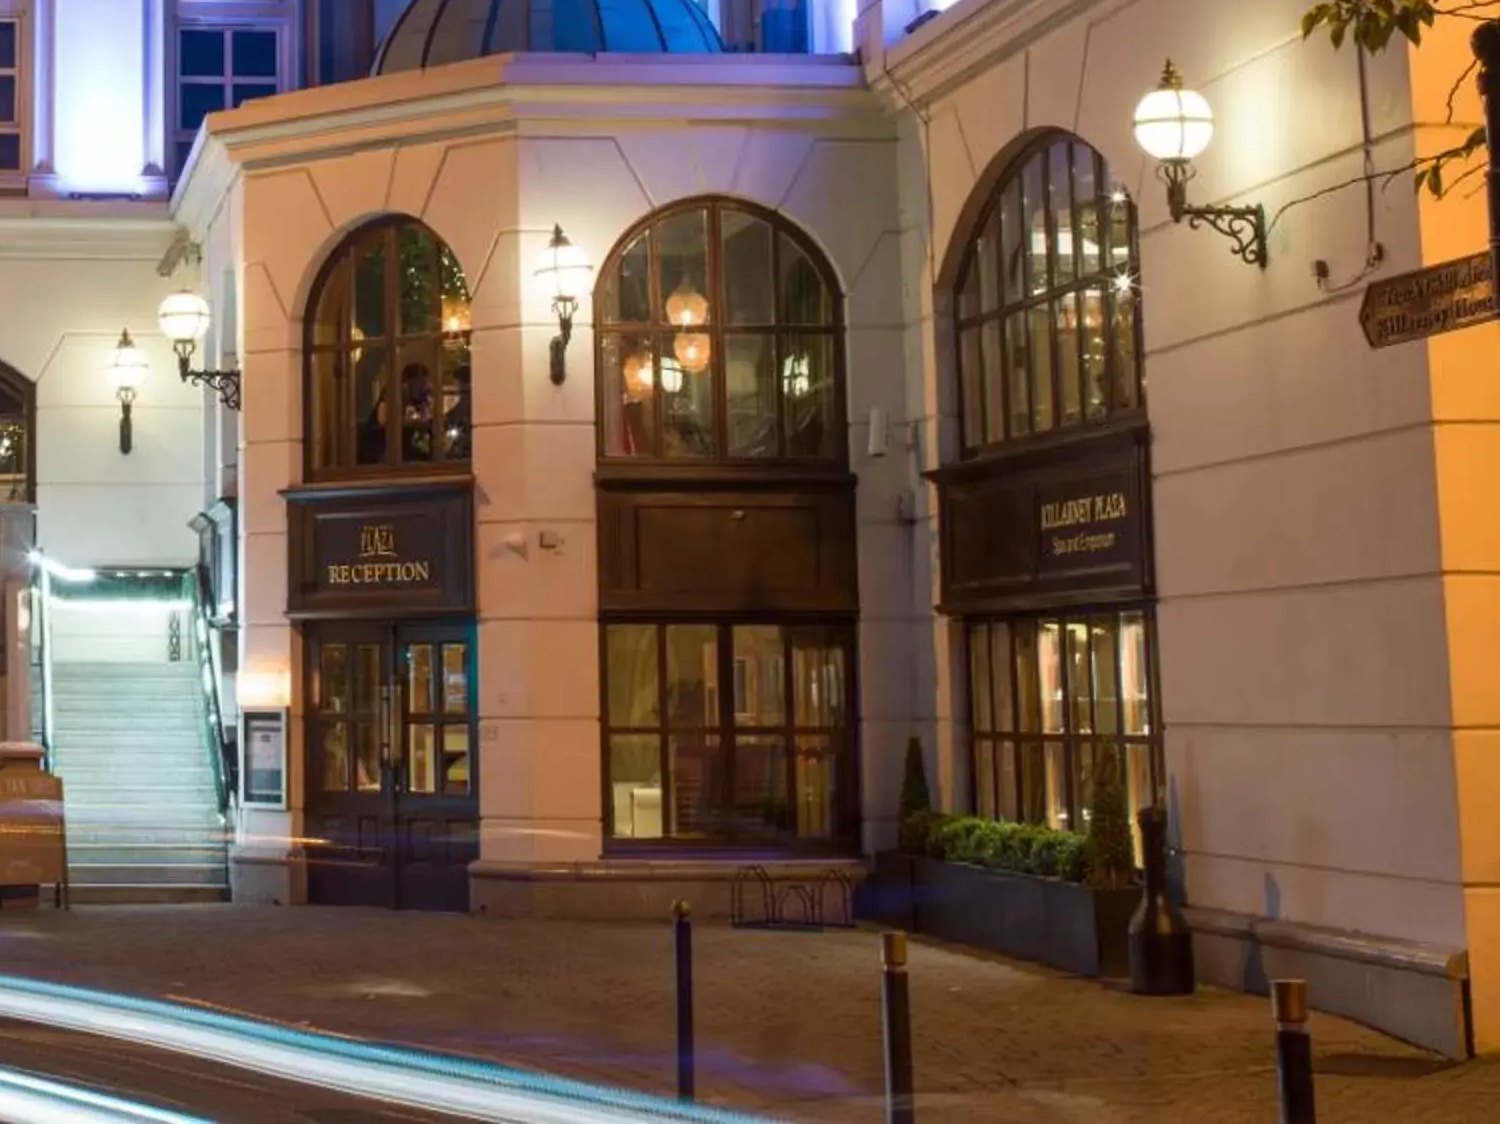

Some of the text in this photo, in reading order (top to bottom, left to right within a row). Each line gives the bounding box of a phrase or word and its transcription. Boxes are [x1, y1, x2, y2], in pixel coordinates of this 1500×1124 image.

[1041, 491, 1127, 529] KILLARNEY PLAZA
[328, 560, 429, 584] RECEPTION
